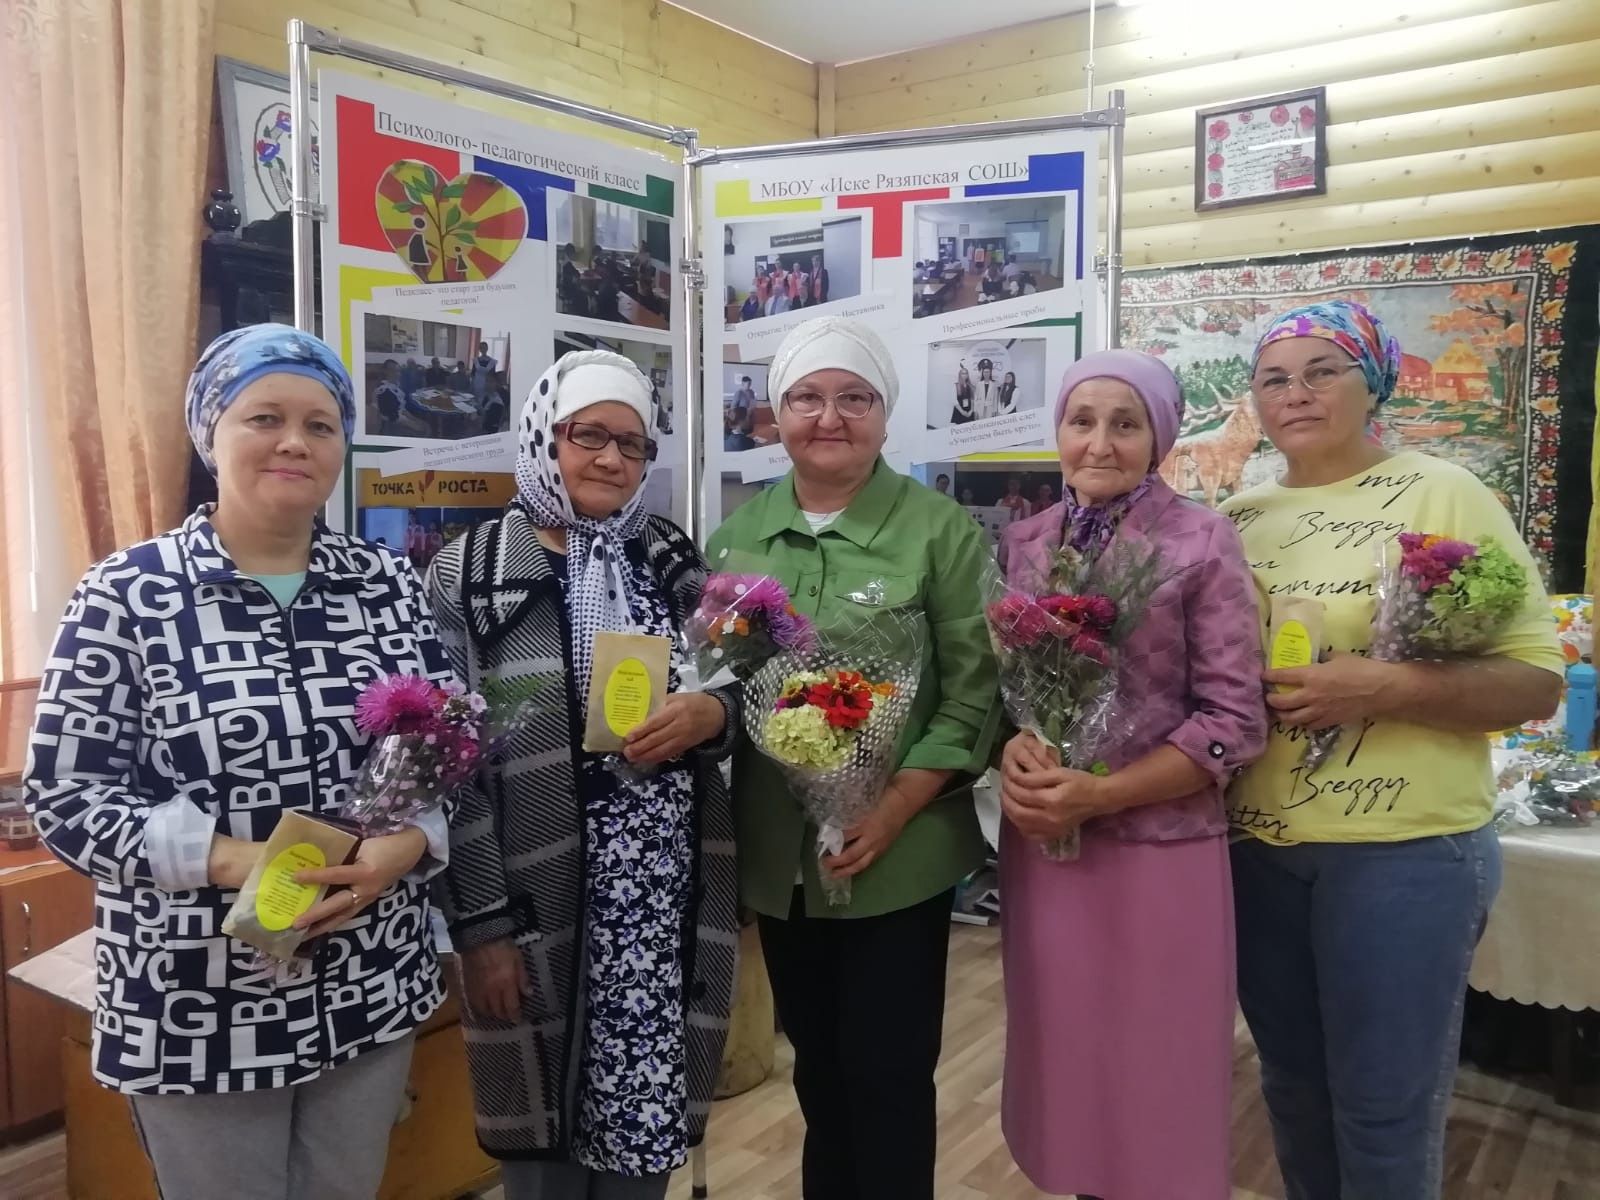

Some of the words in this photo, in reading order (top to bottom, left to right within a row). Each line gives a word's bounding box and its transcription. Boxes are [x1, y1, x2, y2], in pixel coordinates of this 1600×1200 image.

[378, 111, 478, 150] Психолого-
[482, 141, 600, 181] педагогический
[604, 170, 641, 191] класс
[760, 180, 814, 198] МБОУ
[820, 177, 870, 193] «Иске
[876, 170, 959, 188] Рязяпская
[968, 162, 1029, 181] СОШ»
[371, 481, 415, 495] ТОЧКА
[438, 479, 488, 494] РОСТА
